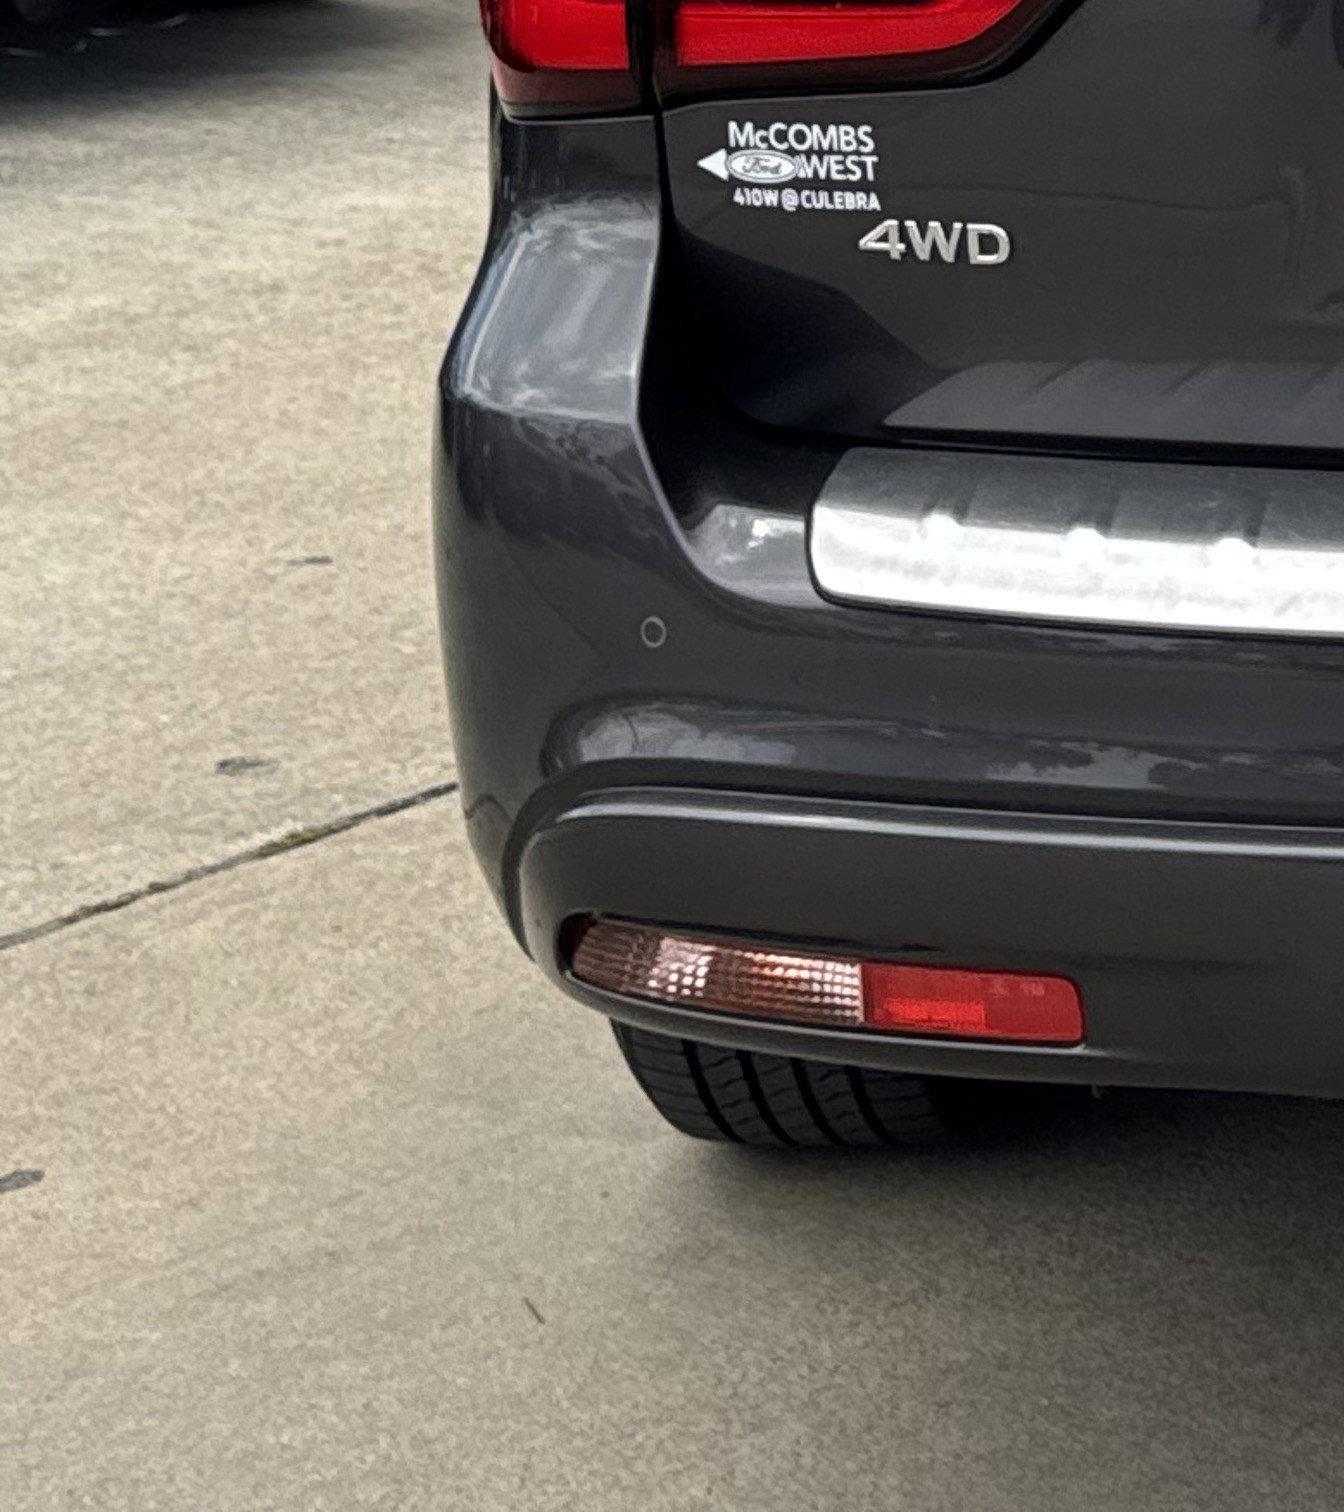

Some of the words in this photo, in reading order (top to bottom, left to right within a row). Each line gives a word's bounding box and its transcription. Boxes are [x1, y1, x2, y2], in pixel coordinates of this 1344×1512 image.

[727, 120, 876, 153] McCOMBS
[741, 155, 782, 175] Ford
[796, 153, 880, 182] WEST
[800, 189, 882, 212] CULEBRA
[858, 219, 1011, 266] 4WD
